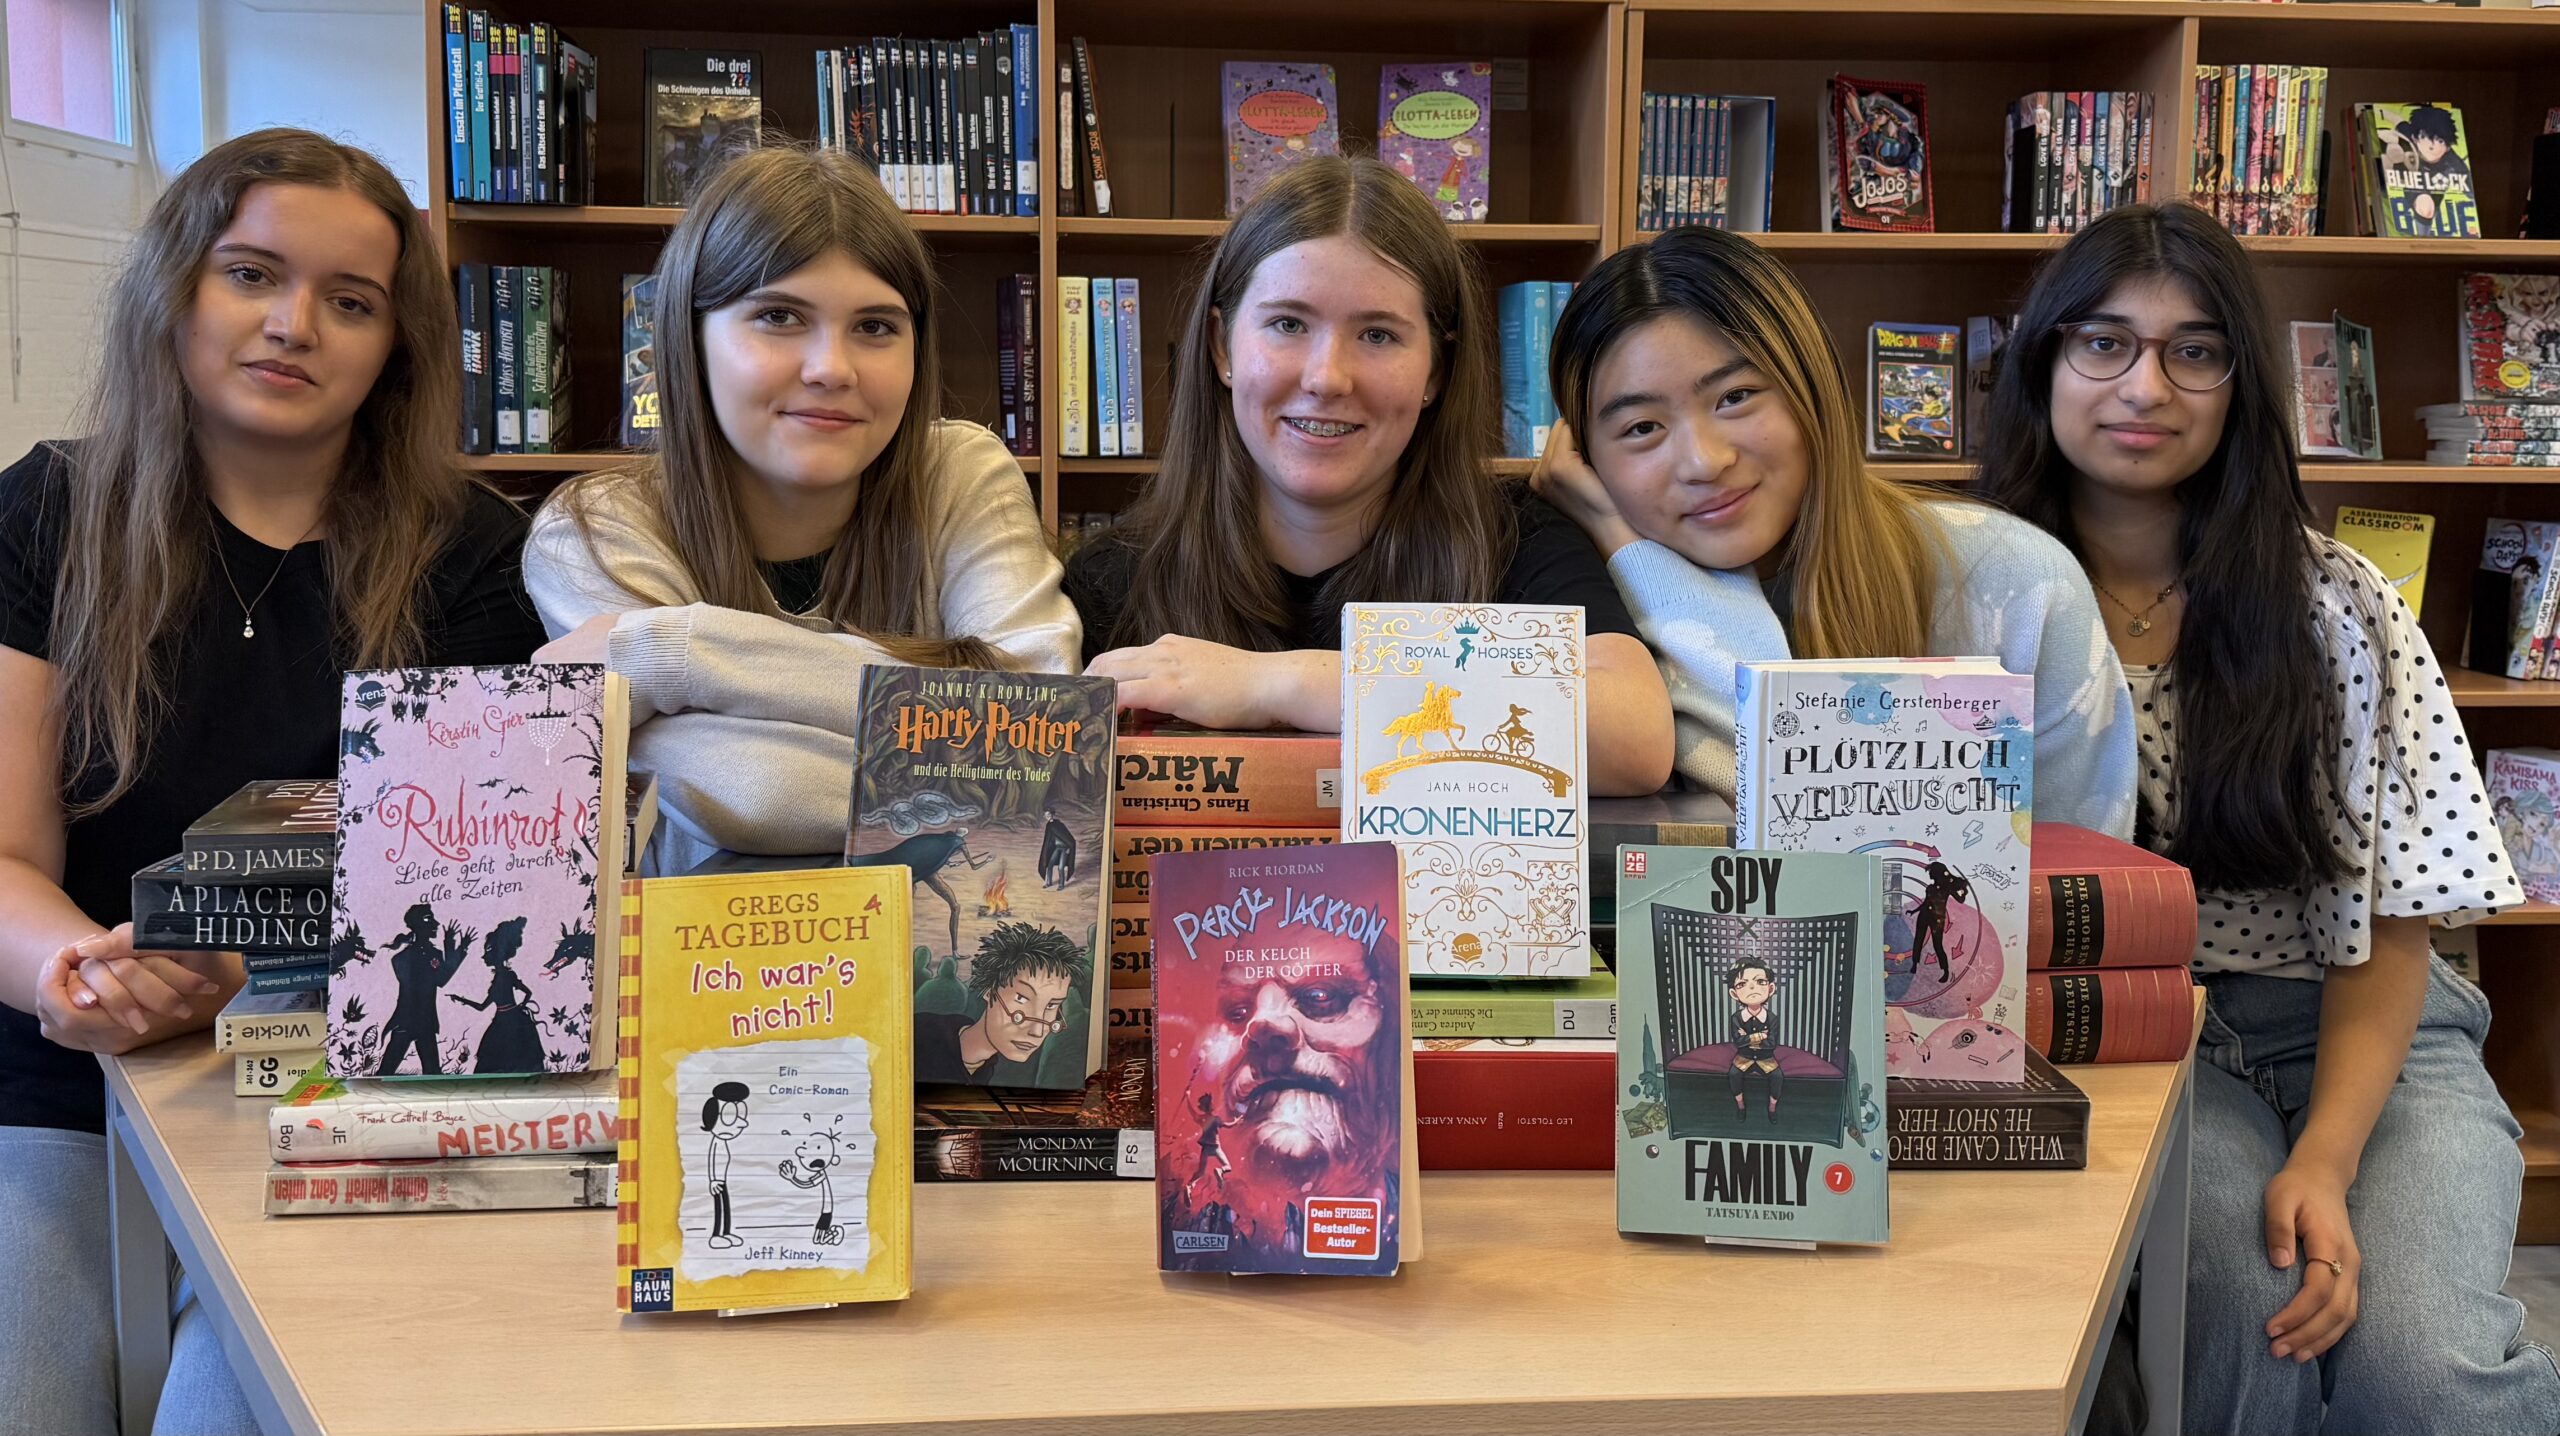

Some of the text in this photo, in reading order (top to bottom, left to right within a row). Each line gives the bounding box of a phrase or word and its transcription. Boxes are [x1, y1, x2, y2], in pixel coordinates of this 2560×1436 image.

[706, 58, 751, 73] Die drei
[657, 84, 670, 94] Die
[671, 85, 710, 96] Schwingen
[711, 87, 724, 95] des
[2386, 169, 2424, 189] BLUE
[1852, 173, 1907, 208] JOJOS
[1877, 328, 1918, 348] DRAGON
[471, 330, 482, 375] HAWK
[2342, 516, 2424, 532] CLASSROOM
[2350, 509, 2421, 522] ASSASSINATION
[2486, 537, 2524, 550] SCHOOL
[1404, 646, 1534, 659] ROYAL HORSES
[355, 686, 387, 702] Arena
[920, 680, 1058, 702] JOANNE K. ROWLING
[1795, 691, 1866, 711] Stefanie
[425, 704, 526, 759] Kerstin Gier
[891, 701, 1082, 765] Harry Potter
[1781, 737, 2011, 775] PLÖTZLICH
[913, 763, 1052, 783] und die Heiligtümer des Todes
[2493, 761, 2557, 785] KAMISAMA
[1322, 779, 1333, 797] JM
[1427, 782, 1510, 793] JANA HOCH
[2510, 776, 2540, 791] KISS
[1122, 797, 1250, 812] Hans Christian
[1771, 776, 2021, 827] VERTAUSCHT
[376, 774, 567, 864] Rubinrot
[1359, 805, 1576, 838] KRONENHERZ
[241, 848, 325, 876] JAMES
[395, 849, 556, 886] Liebe geht durch
[1229, 863, 1325, 878] RICK RIORDAN
[419, 877, 524, 905] alle Zeiten
[1710, 856, 1783, 915] SPY
[167, 885, 327, 915] A PLACE O
[727, 893, 820, 917] GREGS
[863, 893, 882, 916] 4
[194, 916, 319, 946] HIDING
[1172, 886, 1388, 961] PERCY JACKSON
[2061, 878, 2076, 965] DEUTSCHEN
[2076, 877, 2091, 966] DIE GROSSEN
[674, 915, 870, 951] TAGEBUCH
[1224, 947, 1311, 962] DER KELCH
[1451, 940, 1483, 954] Arena
[249, 957, 284, 966] Bibliothek
[1245, 962, 1343, 979] DER GÖTTER
[256, 976, 291, 987] Bibliothek
[692, 954, 857, 994] Ich war's
[730, 988, 834, 1038] nicht!
[1425, 1008, 1493, 1019] Die Stimme der
[1563, 1009, 1575, 1030] DU
[2060, 978, 2076, 1062] DEUTSCHEN
[2074, 977, 2091, 1063] DIE GROSSEN
[241, 1023, 311, 1040] Wickie
[1412, 1020, 1475, 1031] Andrea Cami
[778, 1065, 799, 1077] Ein
[1118, 1056, 1147, 1102] MONDAY
[768, 1083, 849, 1096] Comic-Roman
[356, 1108, 467, 1126] Frank Cottrell Boyce
[1417, 1116, 1487, 1125] ANNA KAREN
[1516, 1117, 1573, 1125] LEO TOLSTOI
[1897, 1107, 2033, 1132] HE SHOT HER
[277, 1124, 294, 1152] Boy
[333, 1126, 347, 1144] JE
[437, 1109, 618, 1159] MEISTERW
[1016, 1136, 1096, 1150] MONDAY
[1125, 1144, 1139, 1164] FS
[1887, 1134, 2065, 1161] WHAT CAME BEFO
[998, 1156, 1114, 1172] MOURNING
[1685, 1139, 1813, 1207] FAMILY
[1834, 1171, 1844, 1186] 7
[310, 1178, 338, 1205] Ganz
[344, 1177, 429, 1204] Günter Wallraff
[1310, 1207, 1374, 1219] Dein SPIEGEL
[1705, 1207, 1795, 1221] TATSUYA ENDO
[1313, 1223, 1371, 1235] Bestseller-
[1175, 1236, 1226, 1248] CARLSEN
[1326, 1236, 1357, 1248] Autor
[744, 1247, 824, 1263] Jeff Kinney
[634, 1280, 671, 1292] BAUM
[634, 1291, 671, 1303] HAUS
